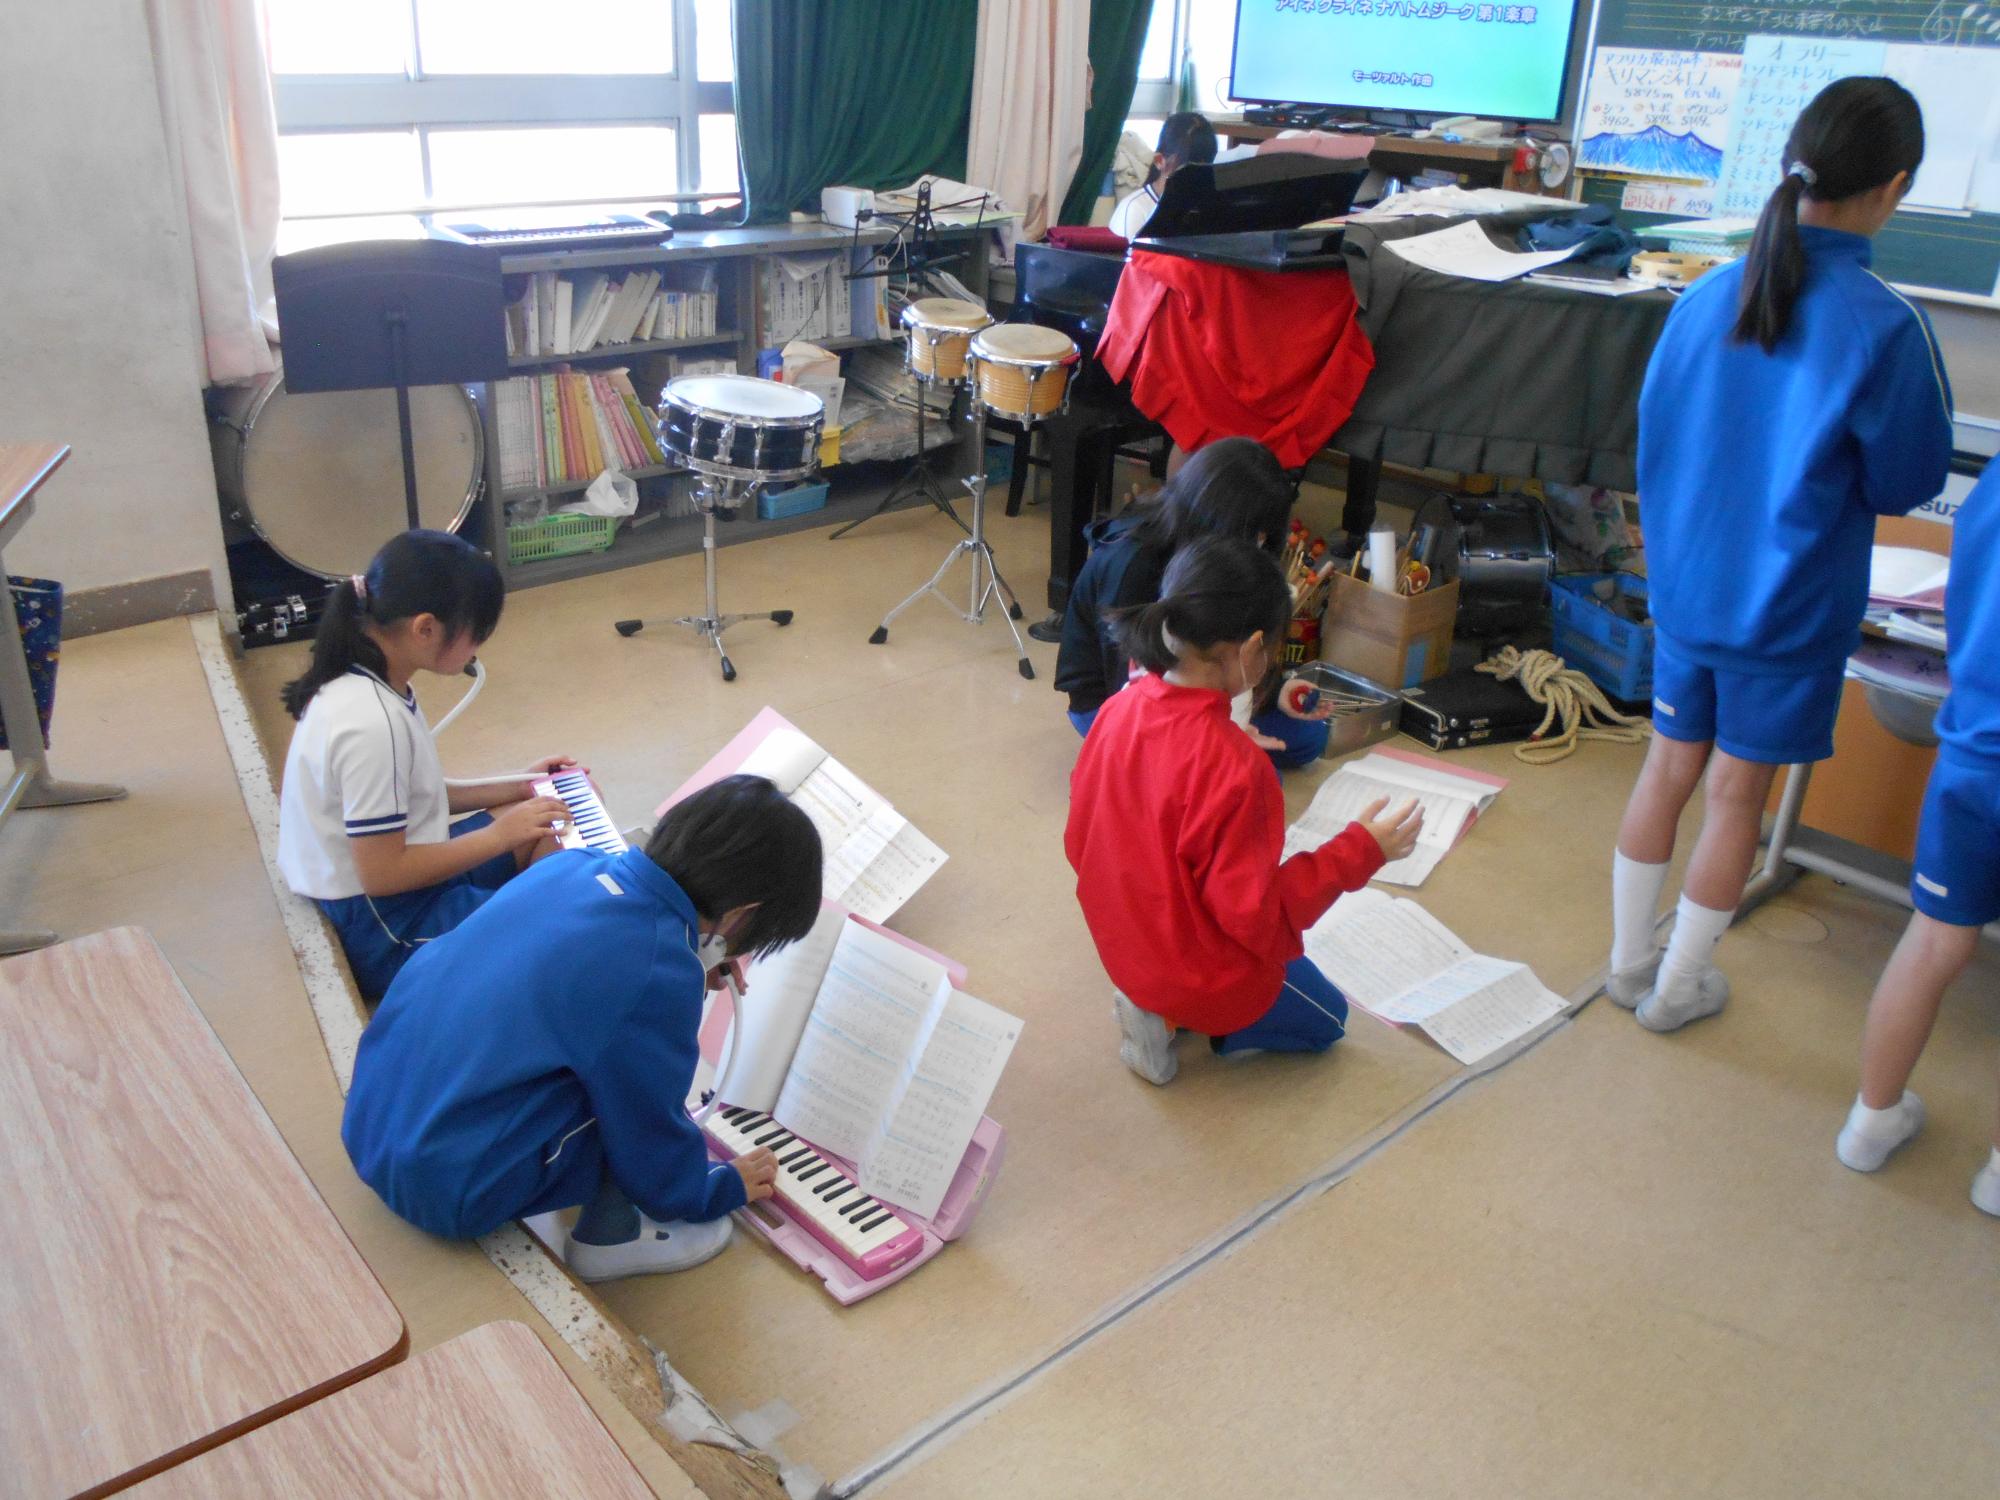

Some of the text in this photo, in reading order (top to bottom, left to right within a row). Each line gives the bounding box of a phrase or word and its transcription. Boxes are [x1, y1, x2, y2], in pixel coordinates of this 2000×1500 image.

[1318, 0, 1373, 15] クライネ
[1376, 0, 1475, 20] ナハトムジーク
[1477, 4, 1537, 24] 第1楽章
[1353, 69, 1433, 88] モーツァルト 作曲
